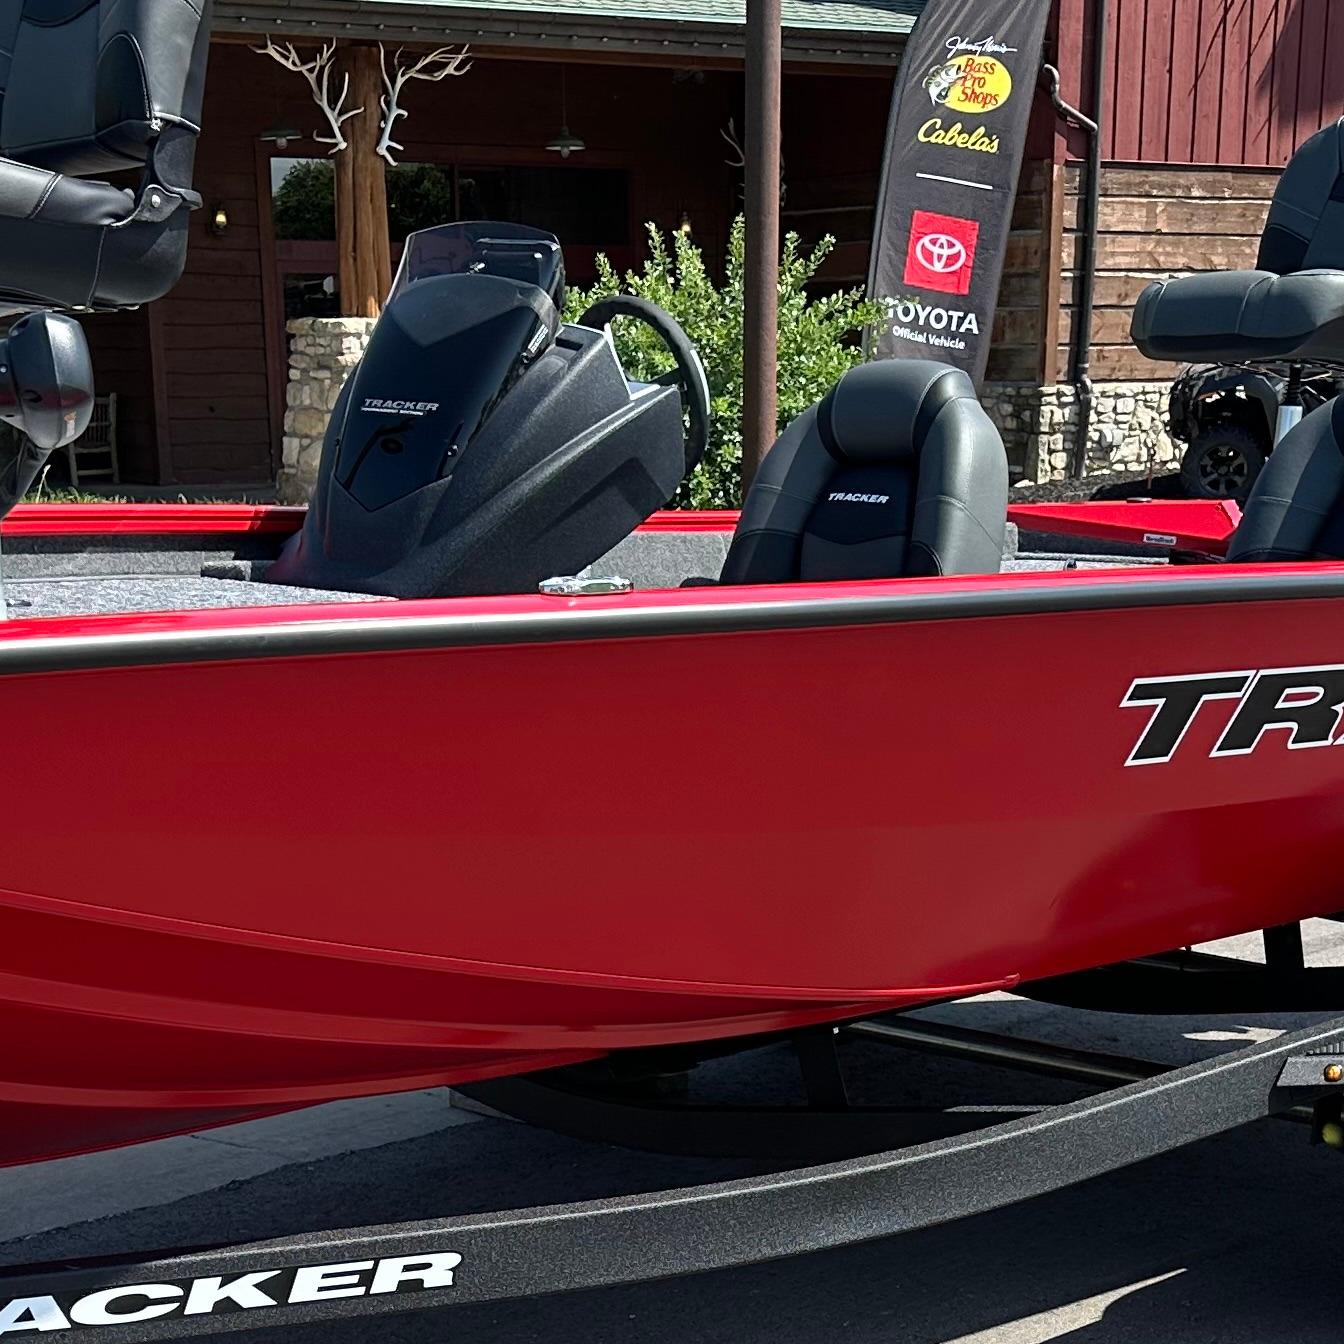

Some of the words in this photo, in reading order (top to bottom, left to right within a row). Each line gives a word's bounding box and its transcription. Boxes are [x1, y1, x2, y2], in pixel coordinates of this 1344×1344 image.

[962, 57, 997, 75] Bass
[960, 73, 986, 89] Pro
[958, 86, 1000, 109] Shops
[917, 118, 999, 153] Cabela's
[885, 297, 979, 335] TOYOTA
[892, 325, 927, 344] Official
[928, 333, 966, 350] Vehicle
[364, 398, 439, 411] TRACKER
[828, 492, 890, 504] TRACKER
